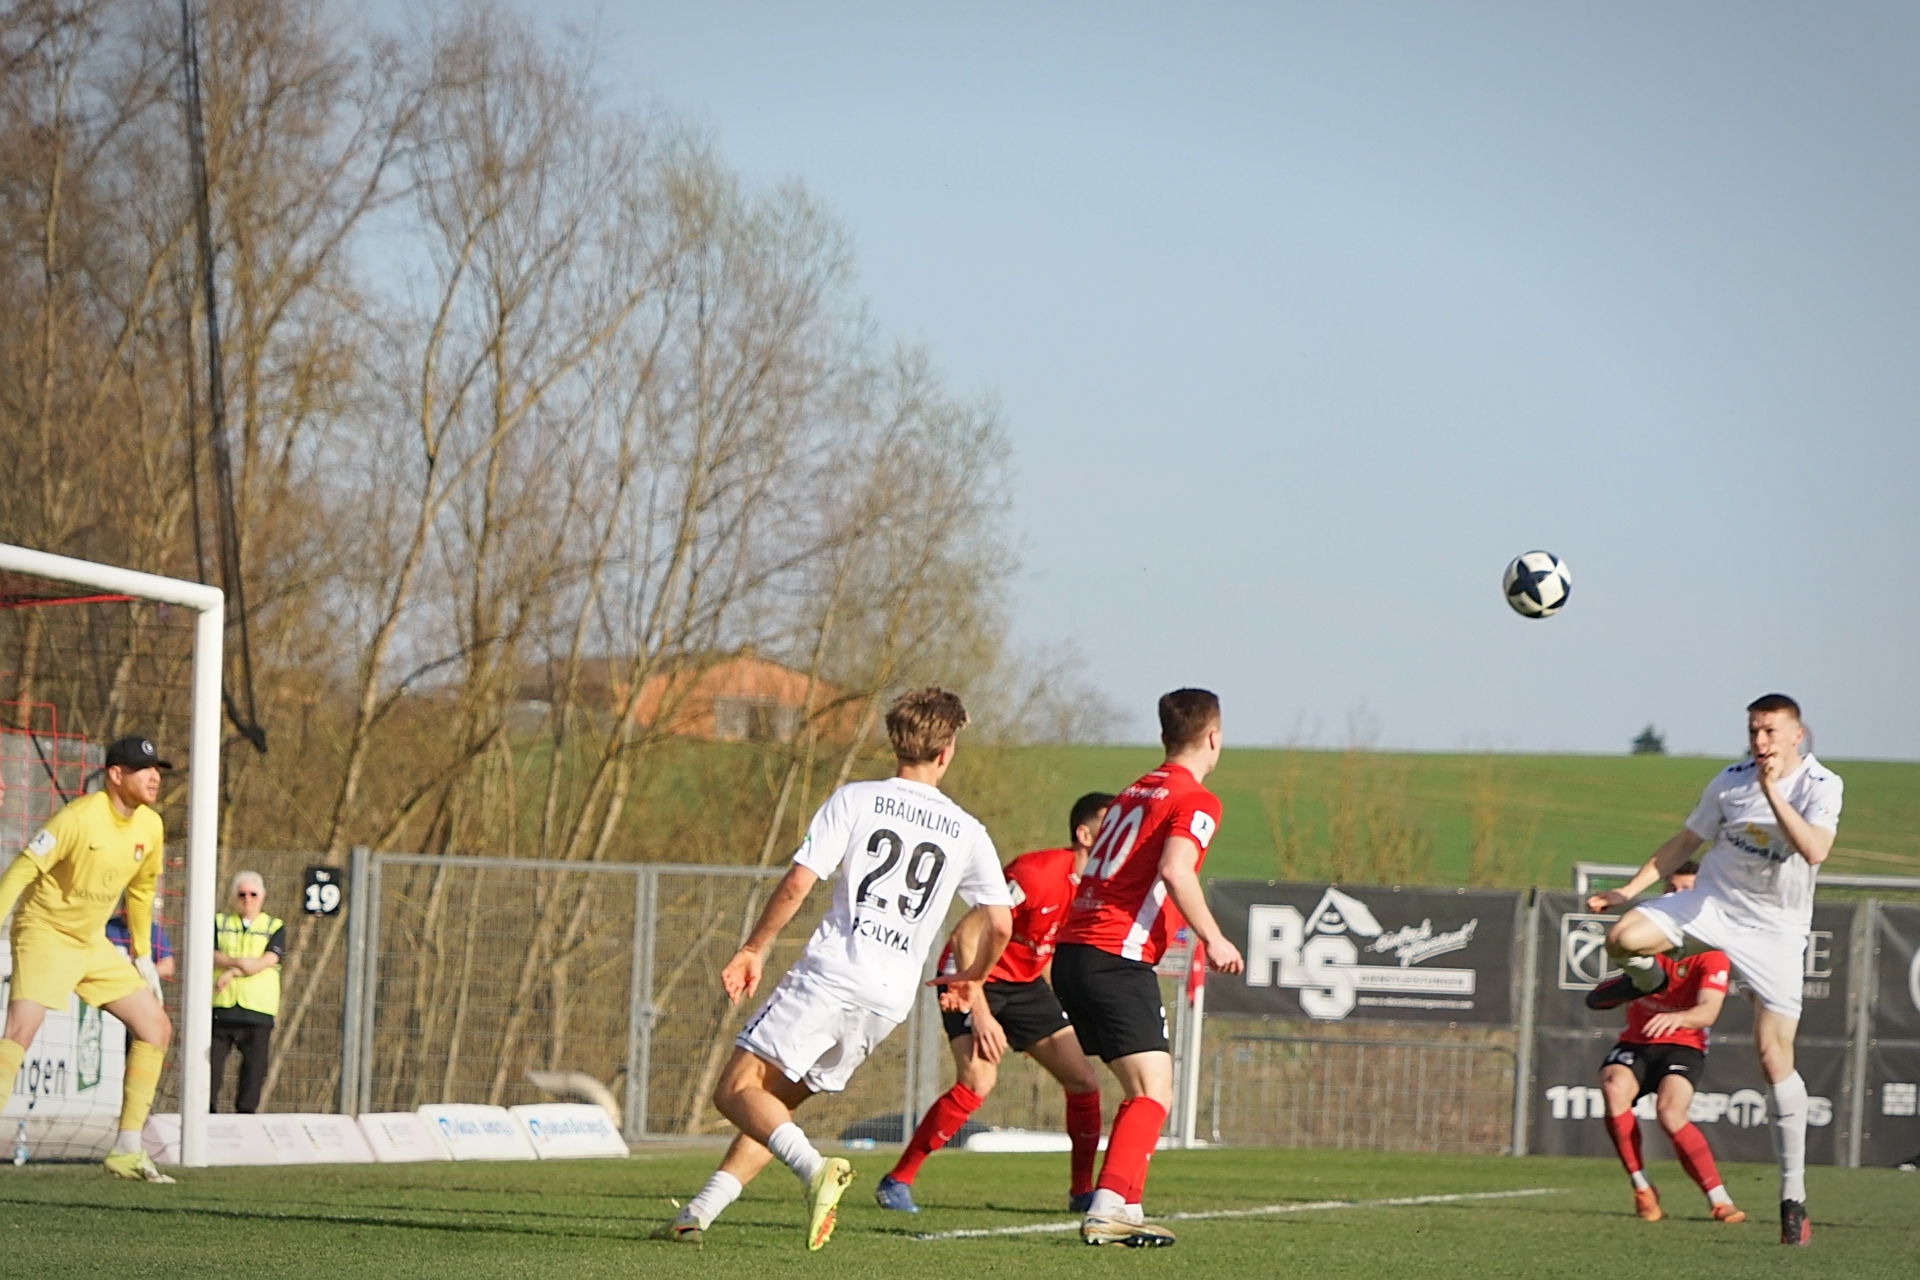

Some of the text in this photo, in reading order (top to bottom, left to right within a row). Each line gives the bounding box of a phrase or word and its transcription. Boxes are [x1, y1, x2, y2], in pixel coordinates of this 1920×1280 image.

[874, 796, 961, 839] BRÄUNLING
[1083, 803, 1144, 880] 20
[305, 883, 341, 913] 19
[856, 828, 948, 924] 29
[13, 1060, 67, 1110] ngen
